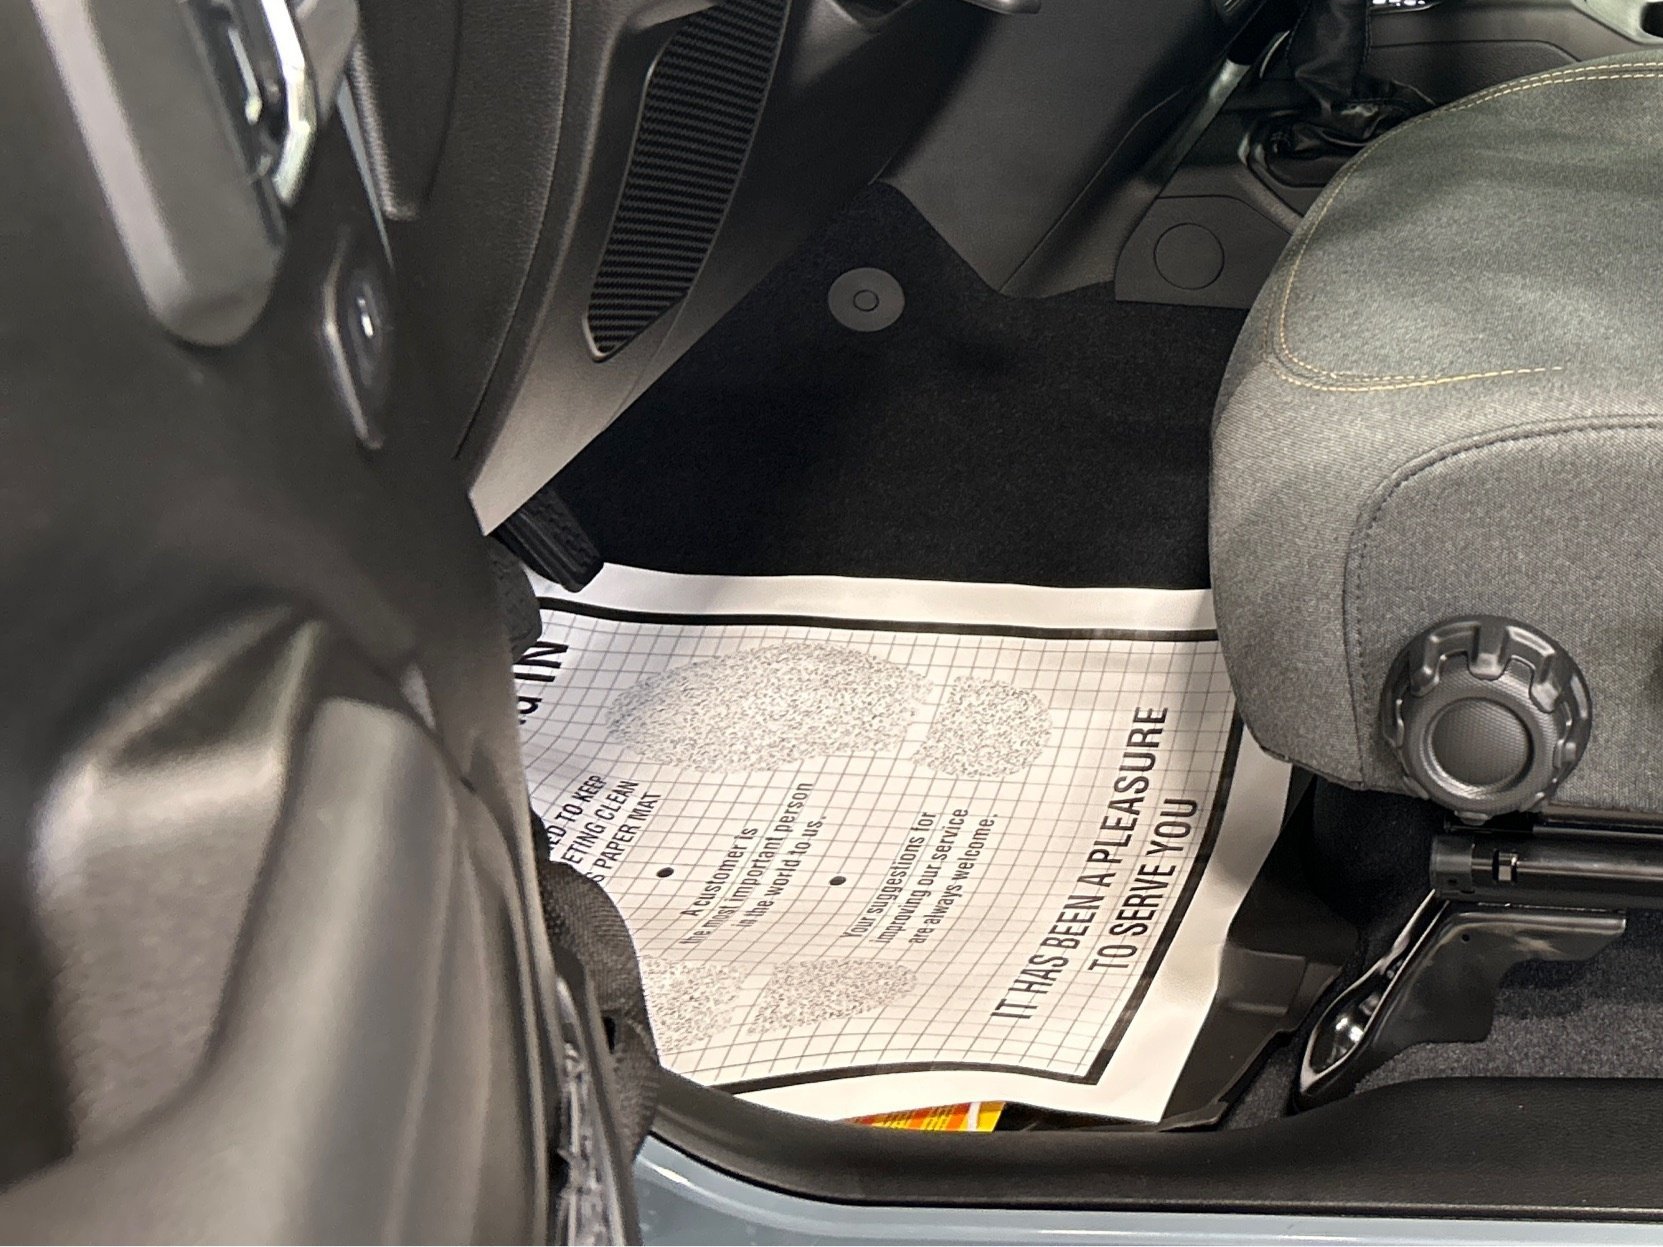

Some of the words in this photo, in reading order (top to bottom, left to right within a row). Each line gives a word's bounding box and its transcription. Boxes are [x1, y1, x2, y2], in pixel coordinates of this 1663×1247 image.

[554, 803, 583, 822] TO
[572, 775, 607, 803] KEEP
[594, 780, 639, 820] CLEAN
[1086, 706, 1169, 864] PLEASURE
[593, 824, 641, 869] PAPER
[627, 792, 661, 821] MAT
[789, 842, 811, 855] to
[802, 816, 826, 838] us.
[1146, 798, 1199, 856] YOU
[679, 930, 711, 944] the
[702, 905, 741, 928] most
[724, 837, 783, 902] important
[774, 783, 813, 832] person
[680, 909, 704, 917] A
[693, 844, 748, 906] customer
[734, 828, 758, 840] is
[764, 859, 801, 896] world
[839, 916, 876, 938] Your
[867, 836, 925, 914] suggestions
[910, 812, 937, 832] for
[869, 890, 931, 943] improving
[917, 864, 942, 886] our
[932, 809, 968, 861] service
[908, 927, 935, 944] are
[923, 884, 963, 925] always
[952, 814, 998, 881] welcome.
[1077, 871, 1116, 888] A
[731, 918, 759, 927] in
[744, 900, 775, 917] the
[1040, 894, 1105, 950] BEEN
[1108, 863, 1177, 937] SERVE
[1008, 953, 1069, 994] HAS
[1088, 943, 1138, 971] TO
[990, 998, 1038, 1019] IT
